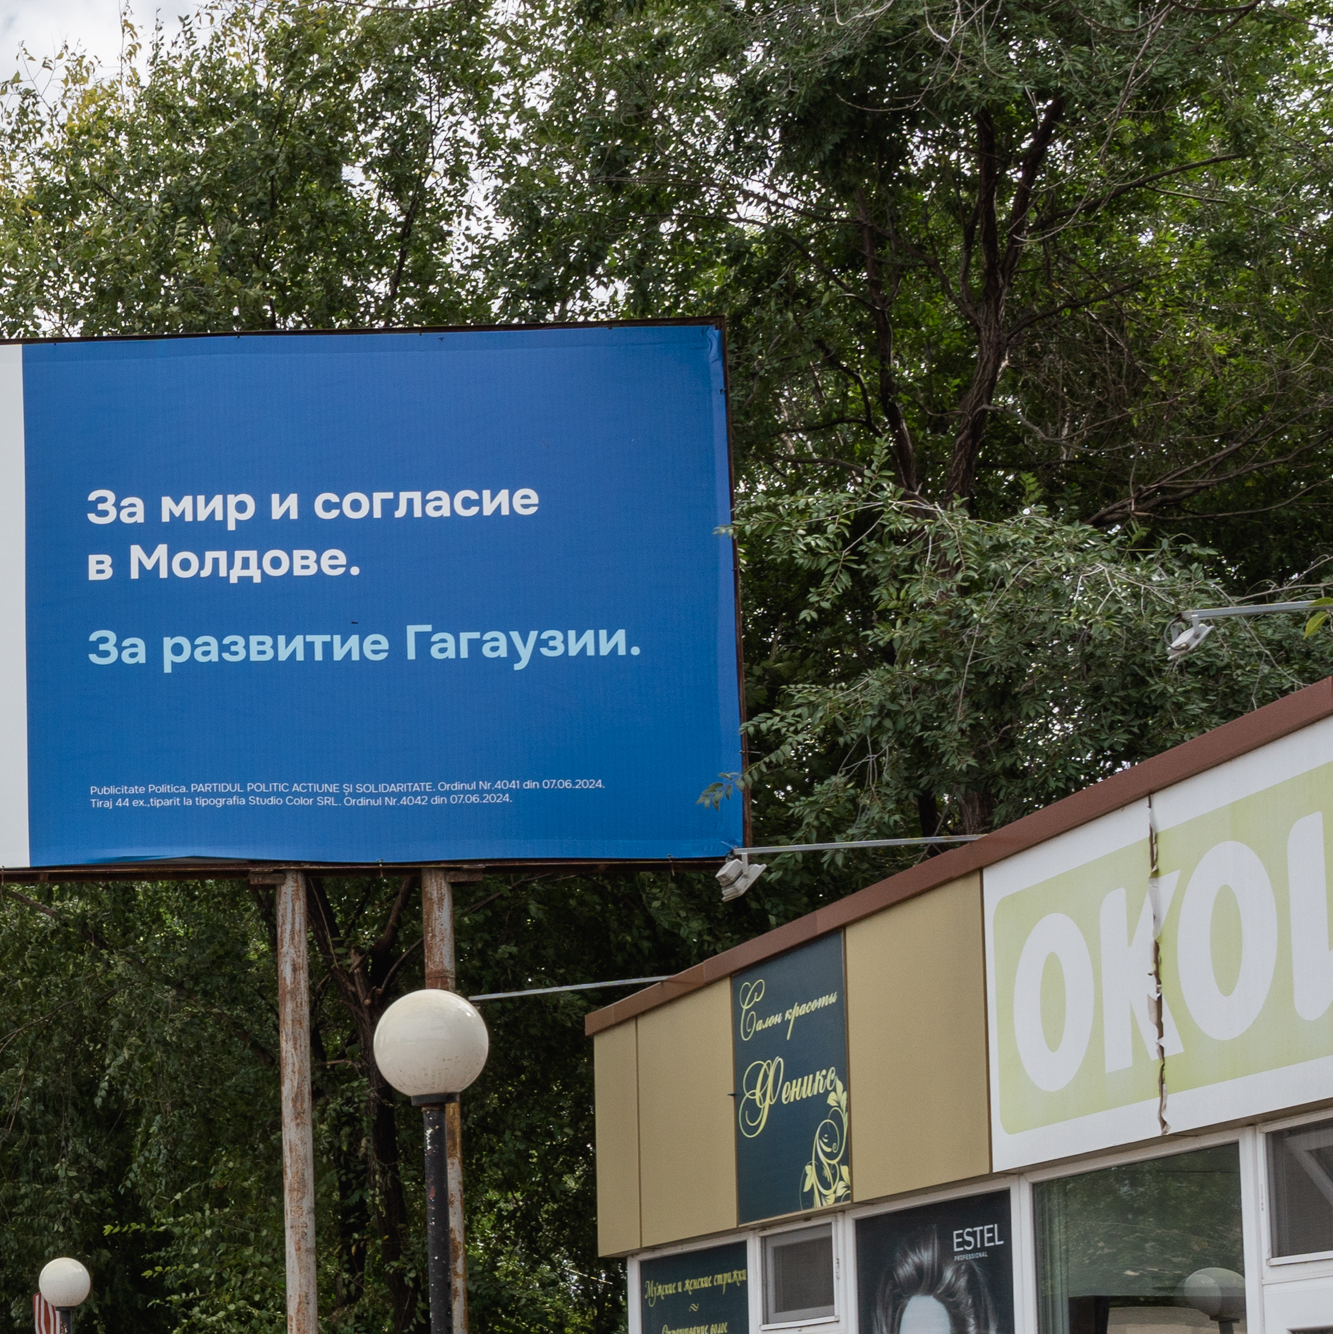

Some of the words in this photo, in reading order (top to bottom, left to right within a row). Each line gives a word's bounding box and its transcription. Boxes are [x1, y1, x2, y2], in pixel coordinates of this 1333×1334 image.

[86, 489, 145, 525] За
[161, 491, 256, 530] мир
[271, 491, 299, 521] и
[314, 487, 539, 519] согласие
[87, 553, 113, 581] в
[130, 544, 361, 584] Молдове.
[88, 630, 147, 666] За
[163, 630, 390, 674] развитие
[406, 624, 642, 671] Гагаузии.
[90, 785, 146, 795] Publicitate
[148, 784, 188, 794] Politica.
[191, 783, 244, 793] PARTIDUL
[247, 782, 290, 793] POLITIC
[292, 783, 340, 793] ACTIUNE
[355, 782, 436, 793] SOLIDARITATE.
[438, 781, 476, 791] Ordinul
[479, 780, 520, 790] Nr.4041
[523, 779, 540, 790] din
[542, 779, 606, 790] 07.06.2024.
[90, 798, 113, 810] Tiraj
[115, 798, 130, 807] 44
[183, 796, 192, 806] la
[195, 795, 246, 808] tipografia
[248, 795, 283, 805] Studio
[285, 795, 313, 806] Color
[316, 796, 342, 807] SRL.
[343, 795, 382, 806] Ordinul
[384, 795, 428, 806] Nr.4042
[430, 794, 447, 805] din
[449, 793, 513, 804] 07.06.2024.
[739, 979, 783, 1041] Салон
[784, 991, 838, 1041] красоты
[738, 1056, 836, 1138] Феникс
[953, 1223, 1004, 1252] ESTEL
[954, 1251, 988, 1261] PROFESSIONAL
